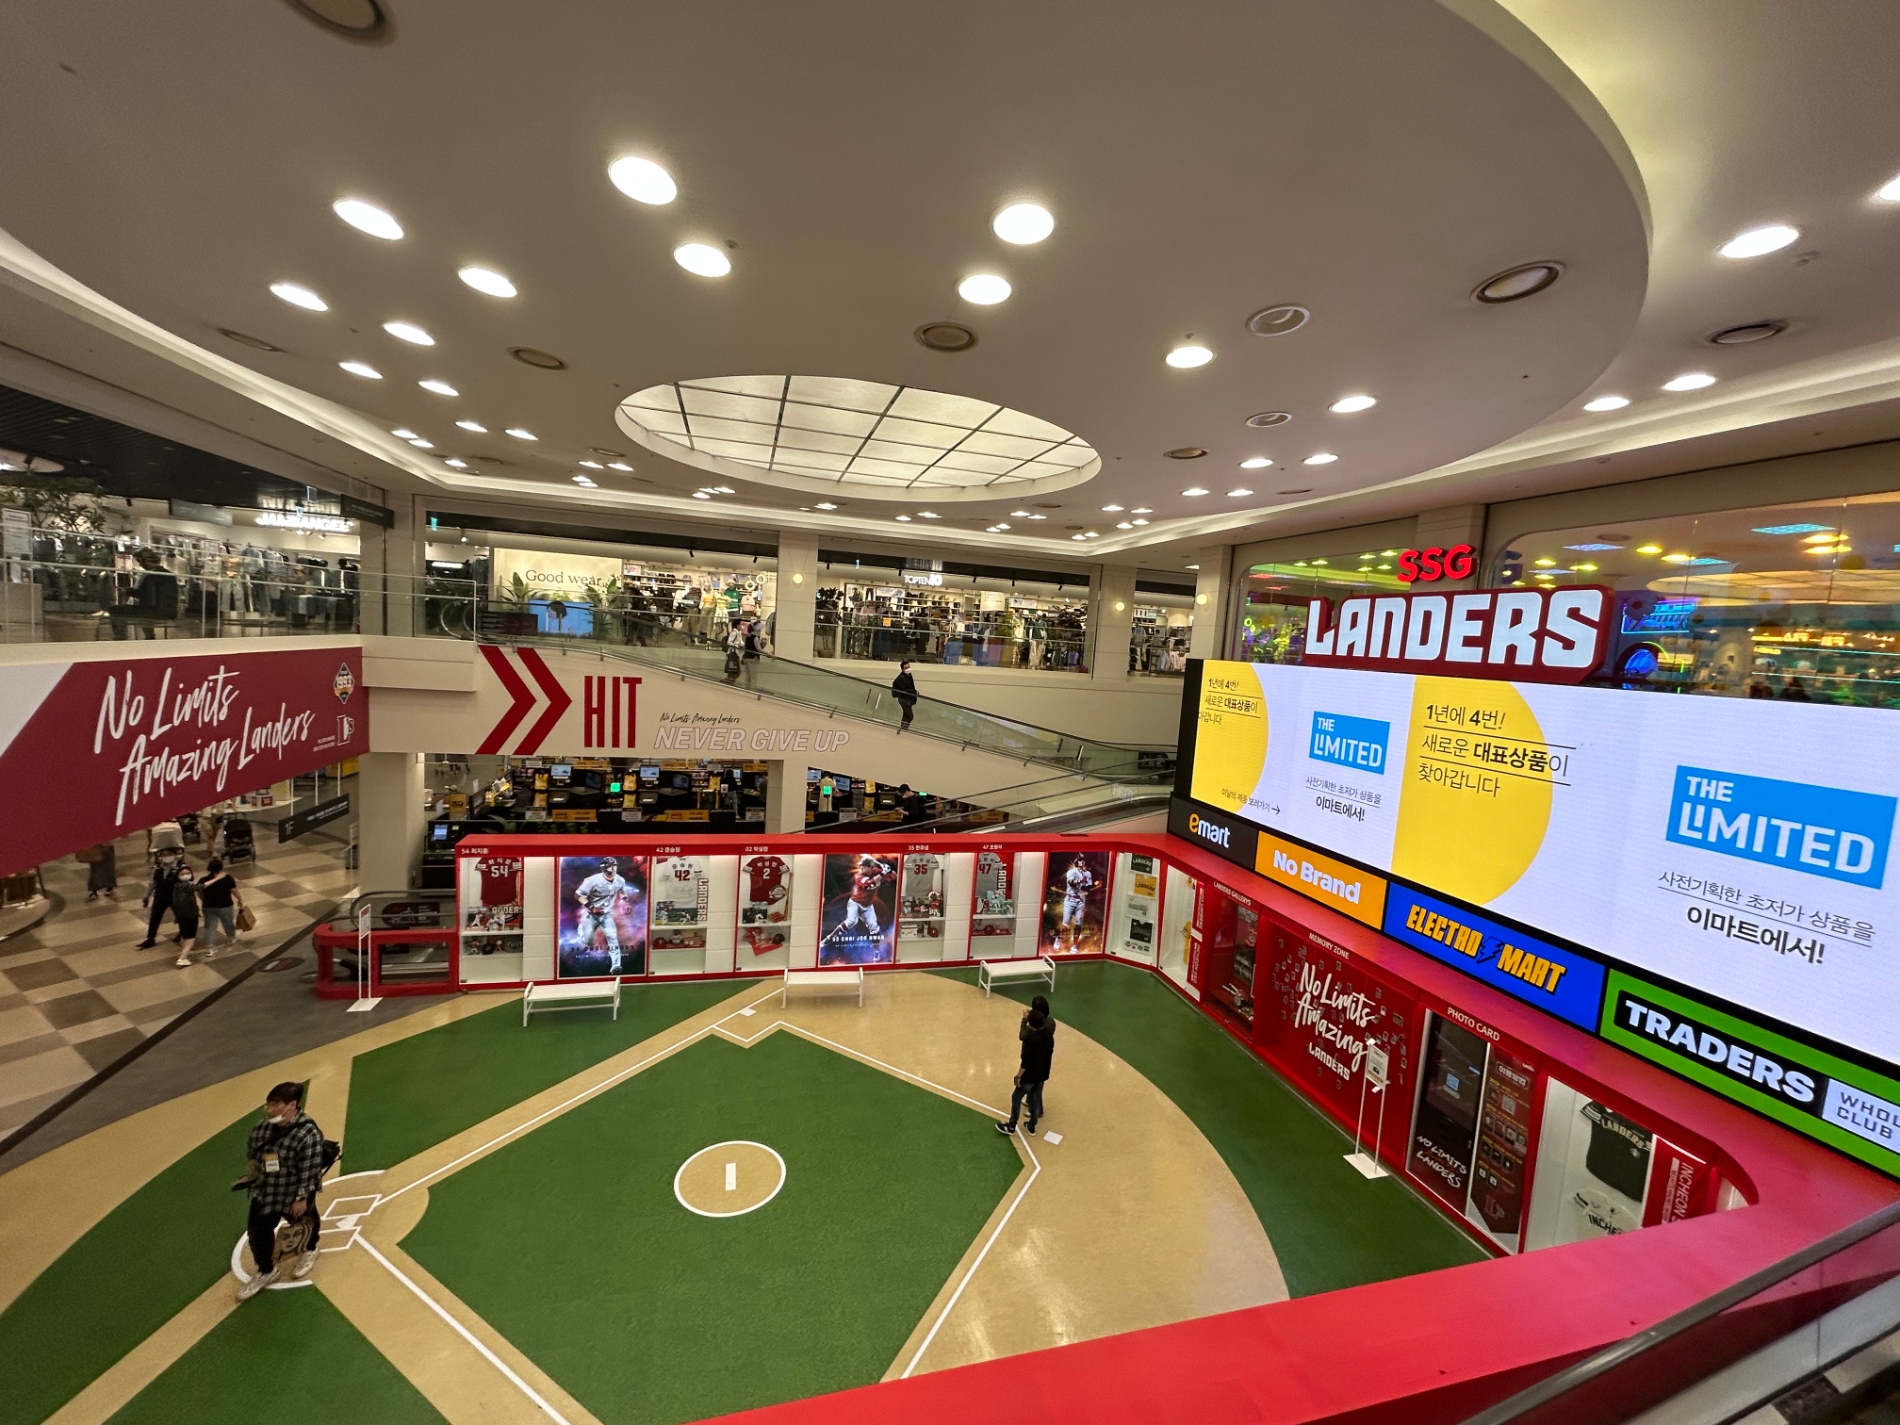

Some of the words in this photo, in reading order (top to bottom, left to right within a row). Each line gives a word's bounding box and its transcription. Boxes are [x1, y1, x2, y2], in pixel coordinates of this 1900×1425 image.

[525, 569, 564, 584] Good
[1397, 544, 1476, 583] SSG
[1305, 589, 1603, 669] LANDERS
[1208, 678, 1224, 690] 1년에
[1225, 680, 1240, 692] 4번!
[94, 669, 145, 754] No
[150, 664, 240, 740] Limits
[584, 675, 642, 748] HIT
[1205, 694, 1224, 708] 새로운
[1224, 696, 1259, 714] 대표상품이
[1426, 704, 1467, 726] 1년에
[1469, 709, 1506, 730] 4번!
[654, 726, 746, 750] NEVER
[751, 728, 811, 751] GIVE
[814, 730, 850, 752] UP
[1317, 717, 1335, 731] THE
[115, 733, 239, 826] Amazing
[237, 702, 316, 770] Landers
[1313, 733, 1383, 767] LIMITED
[1421, 733, 1469, 758] 새로운
[1473, 742, 1569, 777] 대표상품이
[1305, 776, 1337, 792] 사전기획한
[1338, 784, 1358, 798] 초저가
[1359, 790, 1382, 805] 상품을
[1418, 762, 1501, 798] 찾아갑니다
[1686, 776, 1734, 802] THE
[1316, 796, 1365, 822] 이마트에서!
[1188, 813, 1231, 848] emart
[1678, 801, 1875, 874] LIMITED
[491, 865, 509, 878] 54
[674, 869, 691, 882] 42
[762, 867, 771, 880] 2
[914, 863, 929, 876] 35
[978, 863, 992, 875] 47
[1273, 849, 1298, 876] No
[1300, 861, 1361, 905] Brand
[1658, 871, 1743, 905] 사전기획한
[1745, 893, 1805, 922] 초저가
[1808, 910, 1876, 942] 상품을
[1309, 932, 1333, 951] MEMORY
[1332, 946, 1350, 960] ZONE
[1405, 903, 1484, 959] ELECTRO
[1496, 943, 1568, 995] MART
[1687, 906, 1826, 965] 이마트에서!
[1300, 962, 1321, 996] No
[1320, 973, 1376, 1028] Limits
[1295, 992, 1368, 1073] Amazing
[1447, 1006, 1475, 1028] PHOTO
[1475, 1022, 1500, 1042] CARD
[1309, 1042, 1351, 1081] LANDERS
[1624, 999, 1815, 1103] TRADERS
[1601, 1118, 1645, 1149] LANDERS
[1837, 1106, 1893, 1139] CLUB
[1416, 1135, 1433, 1147] NO
[1430, 1145, 1467, 1175] LIMITS
[1416, 1150, 1462, 1188] LANDERS
[1673, 1161, 1695, 1218] INCHEON
